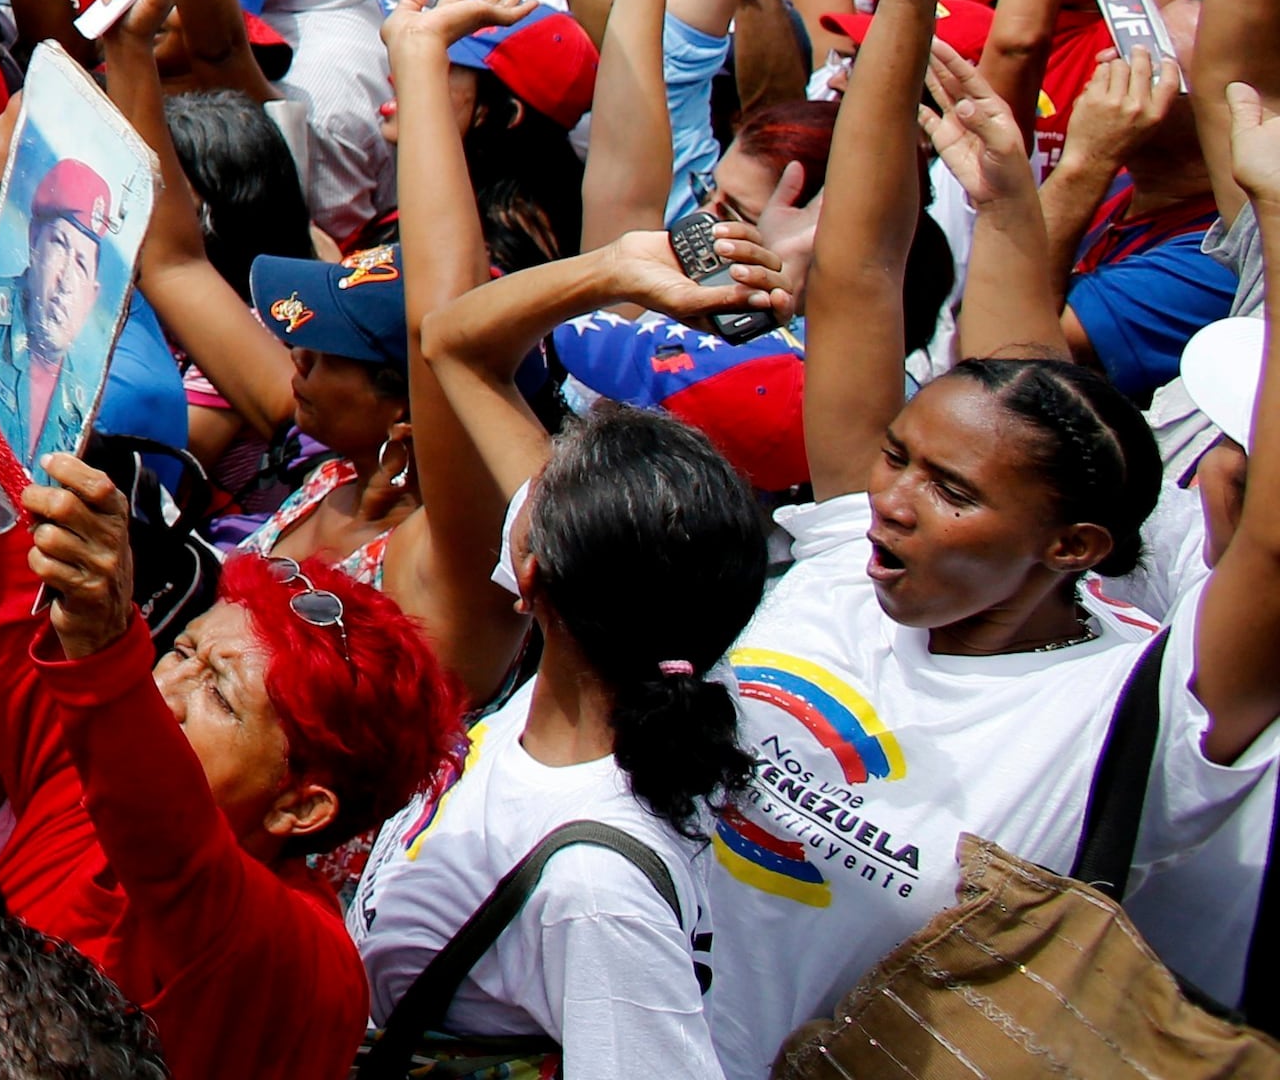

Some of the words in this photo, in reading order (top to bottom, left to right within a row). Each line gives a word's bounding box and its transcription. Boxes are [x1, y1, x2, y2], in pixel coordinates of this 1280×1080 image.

[753, 758, 920, 871] VENEZUELA
[761, 735, 815, 783] Nos
[820, 782, 864, 809] une
[747, 789, 913, 898] nstituyente
